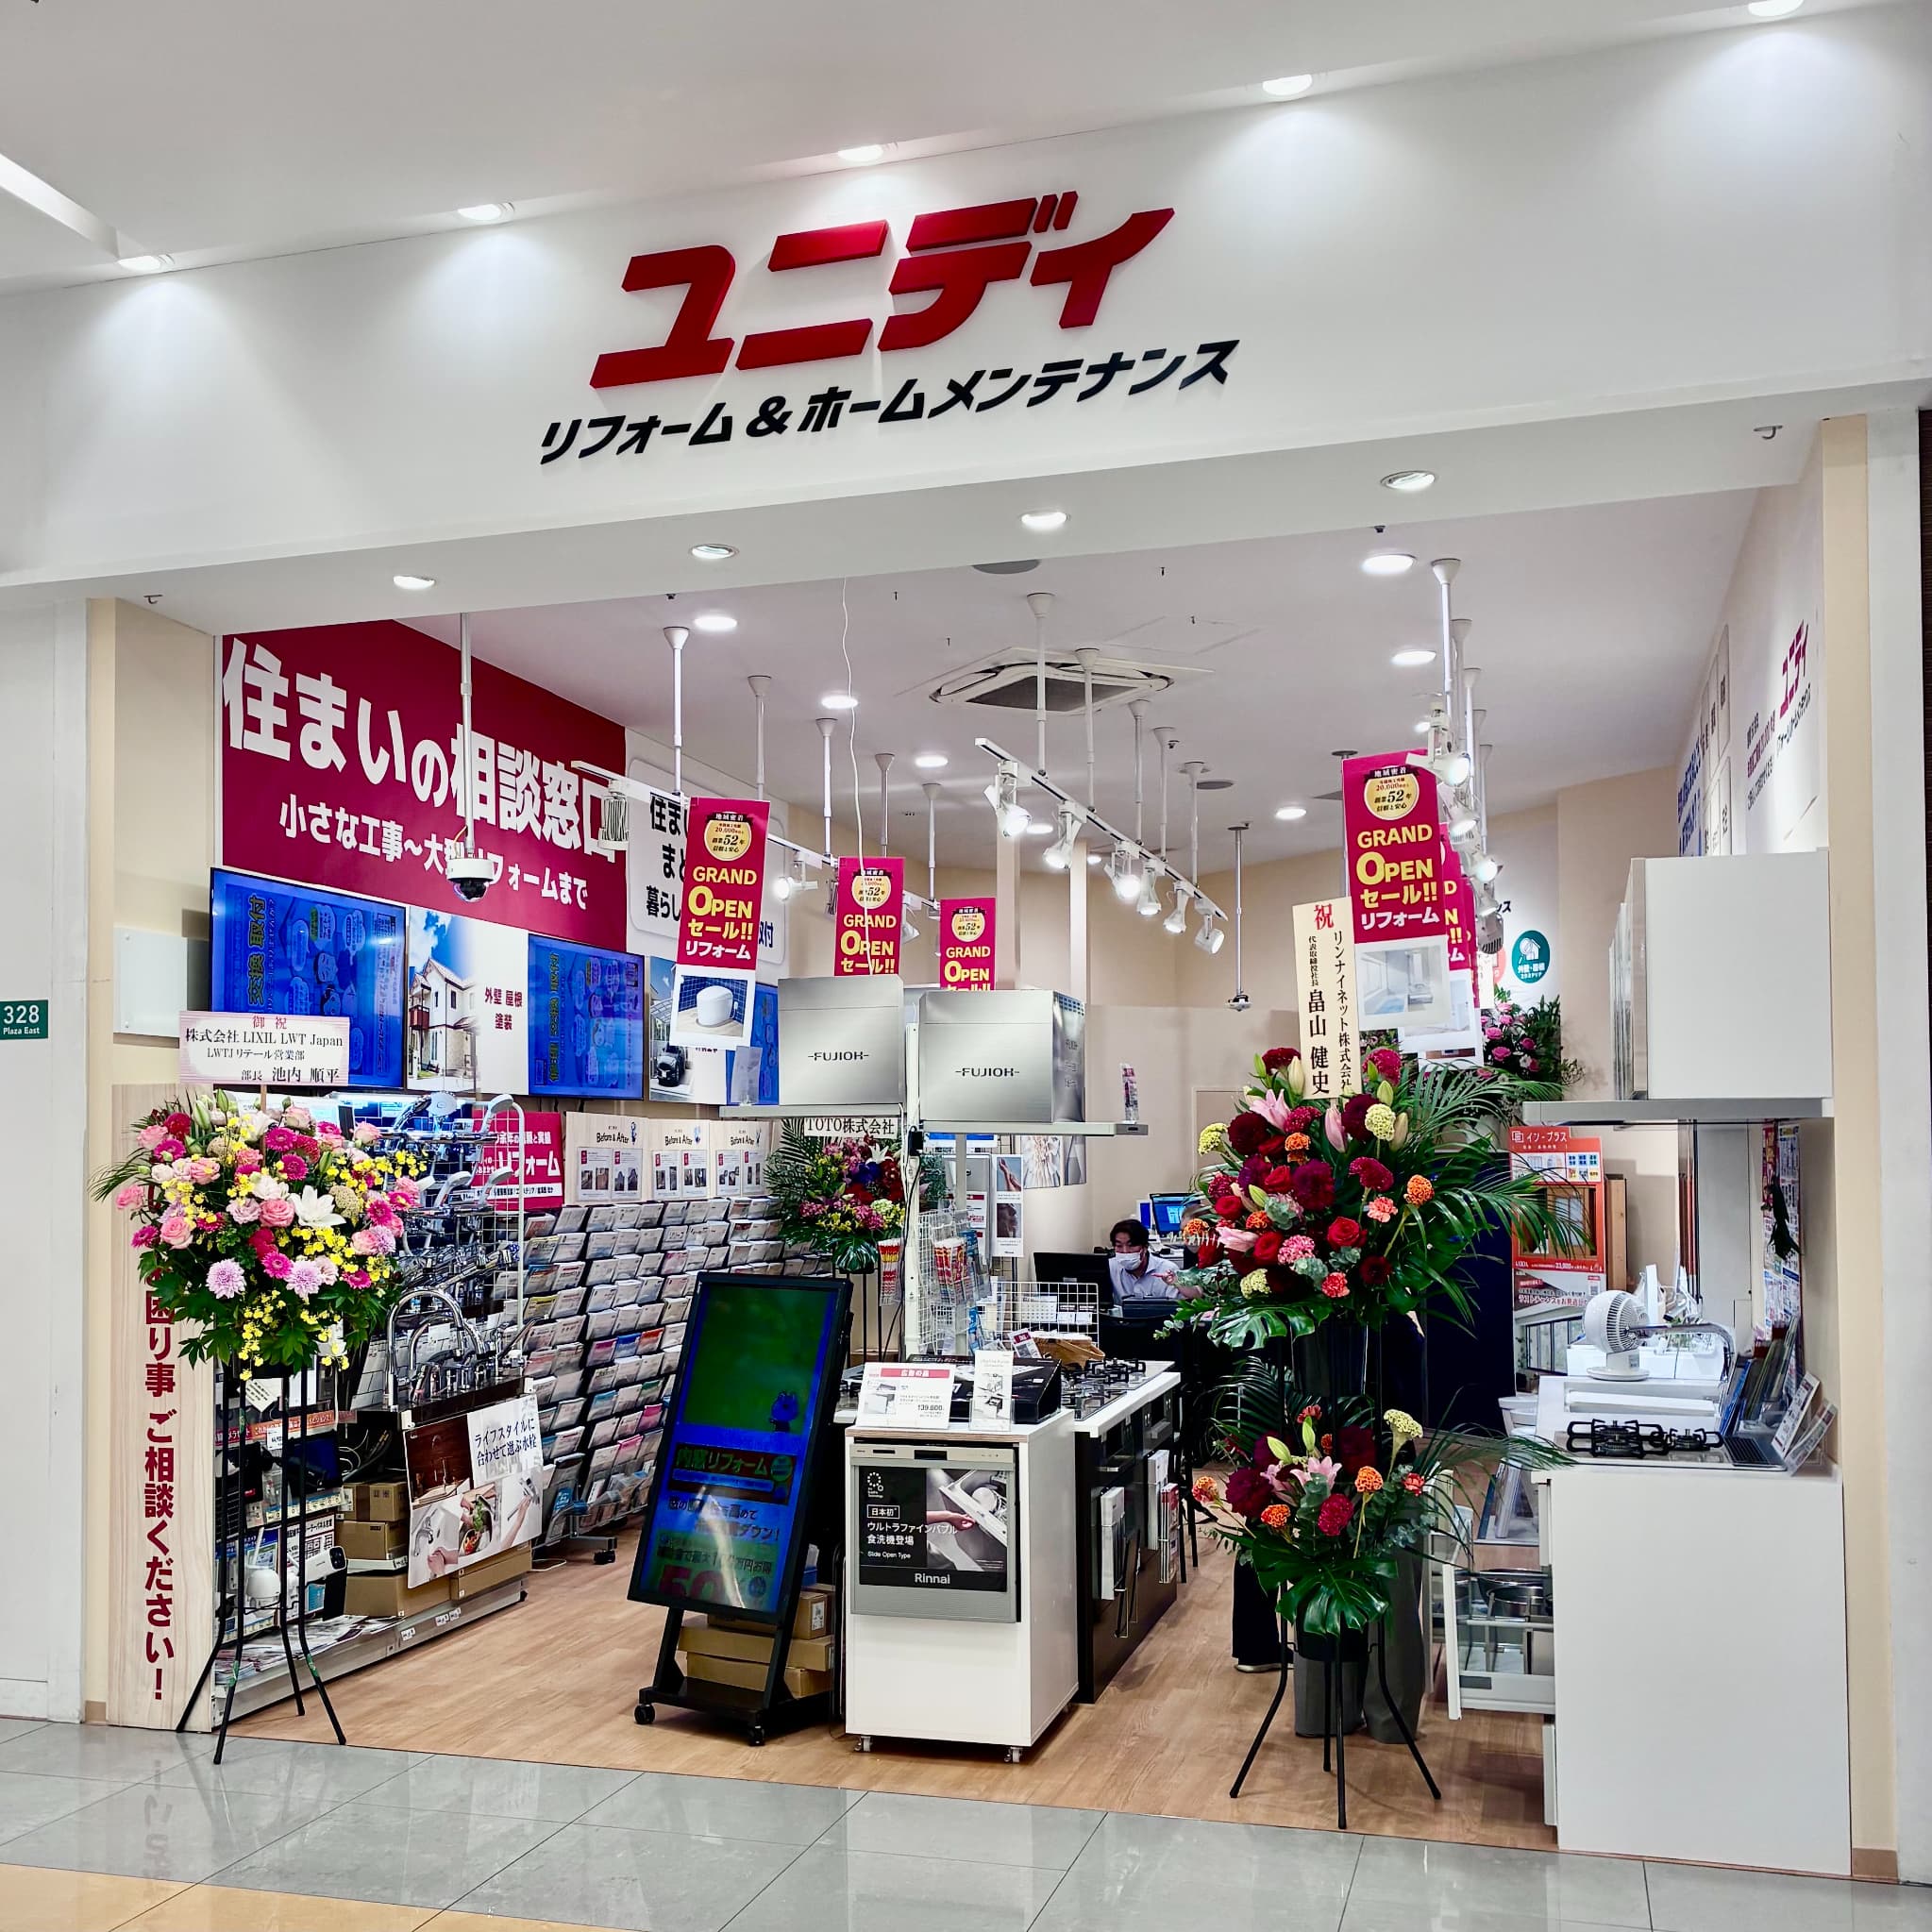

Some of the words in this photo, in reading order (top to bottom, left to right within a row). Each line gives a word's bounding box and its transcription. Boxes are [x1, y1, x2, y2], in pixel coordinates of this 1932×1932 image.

[589, 191, 1175, 389] ユニディ
[1357, 824, 1433, 848] GRAND
[693, 866, 757, 885] GRAND
[1356, 851, 1433, 885] OPEN
[688, 886, 753, 919] OPEN
[248, 894, 266, 949] 取付
[843, 915, 897, 928] GRAND
[1314, 903, 1334, 930] 祝
[1361, 906, 1440, 930] リフォーム
[685, 941, 751, 960] リフォーム
[840, 930, 894, 956] OPEN
[946, 947, 990, 958] GRAND
[944, 960, 989, 983] OPEN
[484, 986, 501, 1004] 外壁
[505, 990, 522, 1007] 屋根
[4, 1005, 39, 1024] 328
[3, 1027, 22, 1035] Plaza
[185, 1028, 240, 1044] 株式会社
[244, 1032, 276, 1044] LIXIL
[280, 1033, 307, 1046] LWT
[310, 1033, 344, 1047] Japan
[474, 1418, 535, 1449] ライフスタイルに
[477, 1434, 537, 1468] 合わせて選ぶ水栓
[867, 1521, 958, 1535] ウルトラファインバブル
[866, 1535, 915, 1546] 食洗機登場
[915, 1572, 950, 1585] Rinnai
